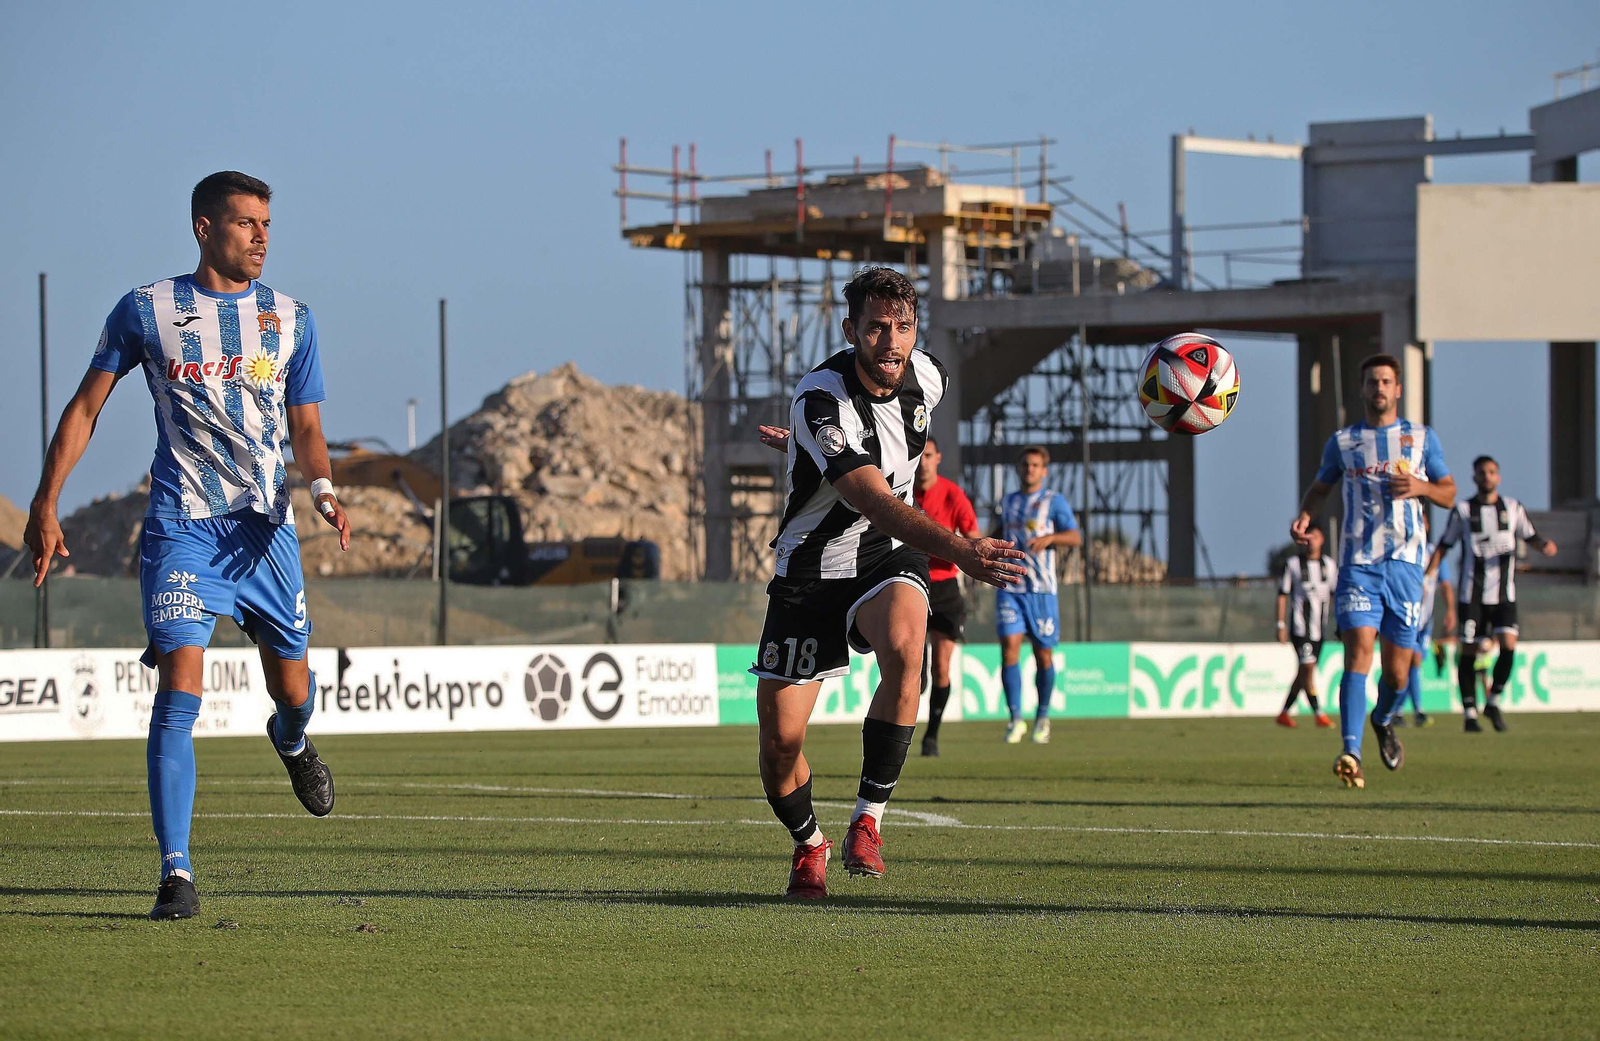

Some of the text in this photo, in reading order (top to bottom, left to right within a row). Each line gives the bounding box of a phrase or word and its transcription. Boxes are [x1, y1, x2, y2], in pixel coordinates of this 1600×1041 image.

[293, 590, 307, 629] 5
[115, 660, 159, 693] PEN
[784, 637, 818, 677] 18
[314, 658, 504, 721] reekickpro
[637, 689, 713, 716] Emotion
